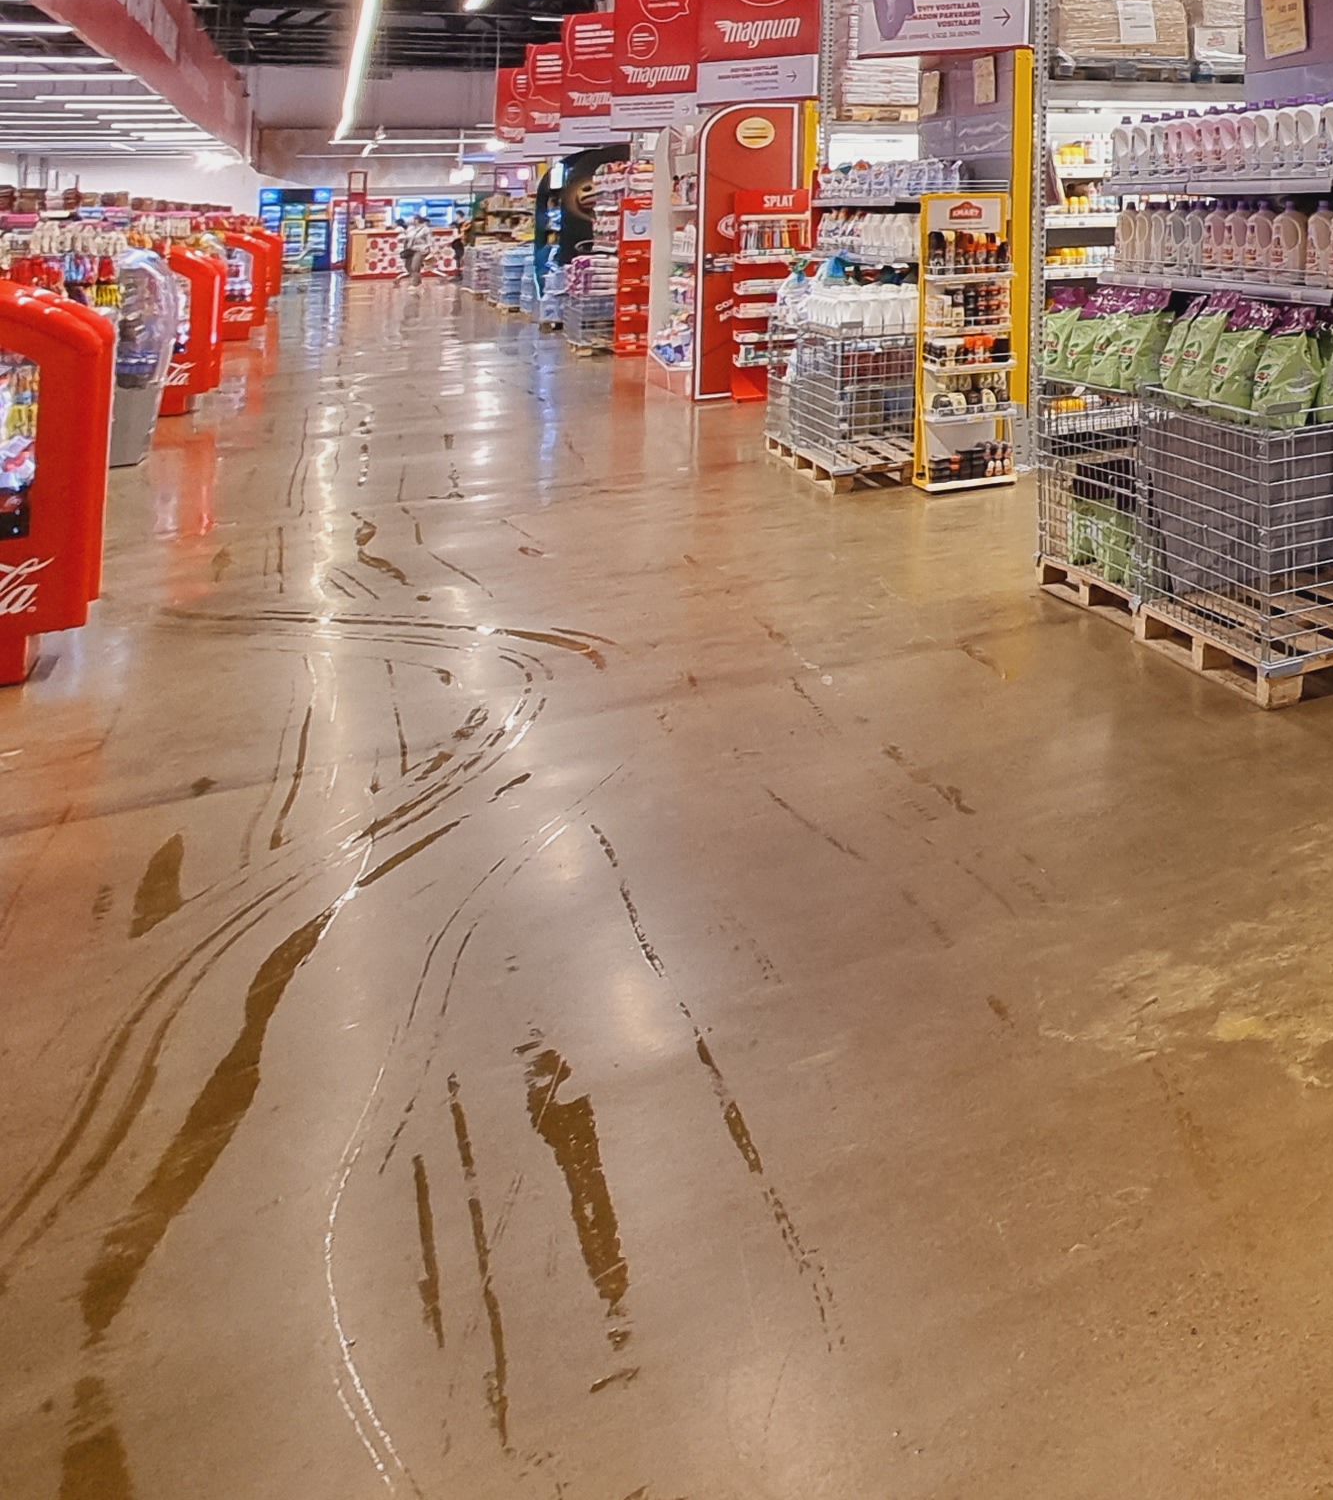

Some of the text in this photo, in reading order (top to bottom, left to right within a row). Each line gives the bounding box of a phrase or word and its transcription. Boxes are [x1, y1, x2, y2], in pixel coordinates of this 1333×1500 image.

[714, 17, 801, 49] magnum
[619, 64, 691, 89] magnum
[763, 194, 795, 209] SPLAT
